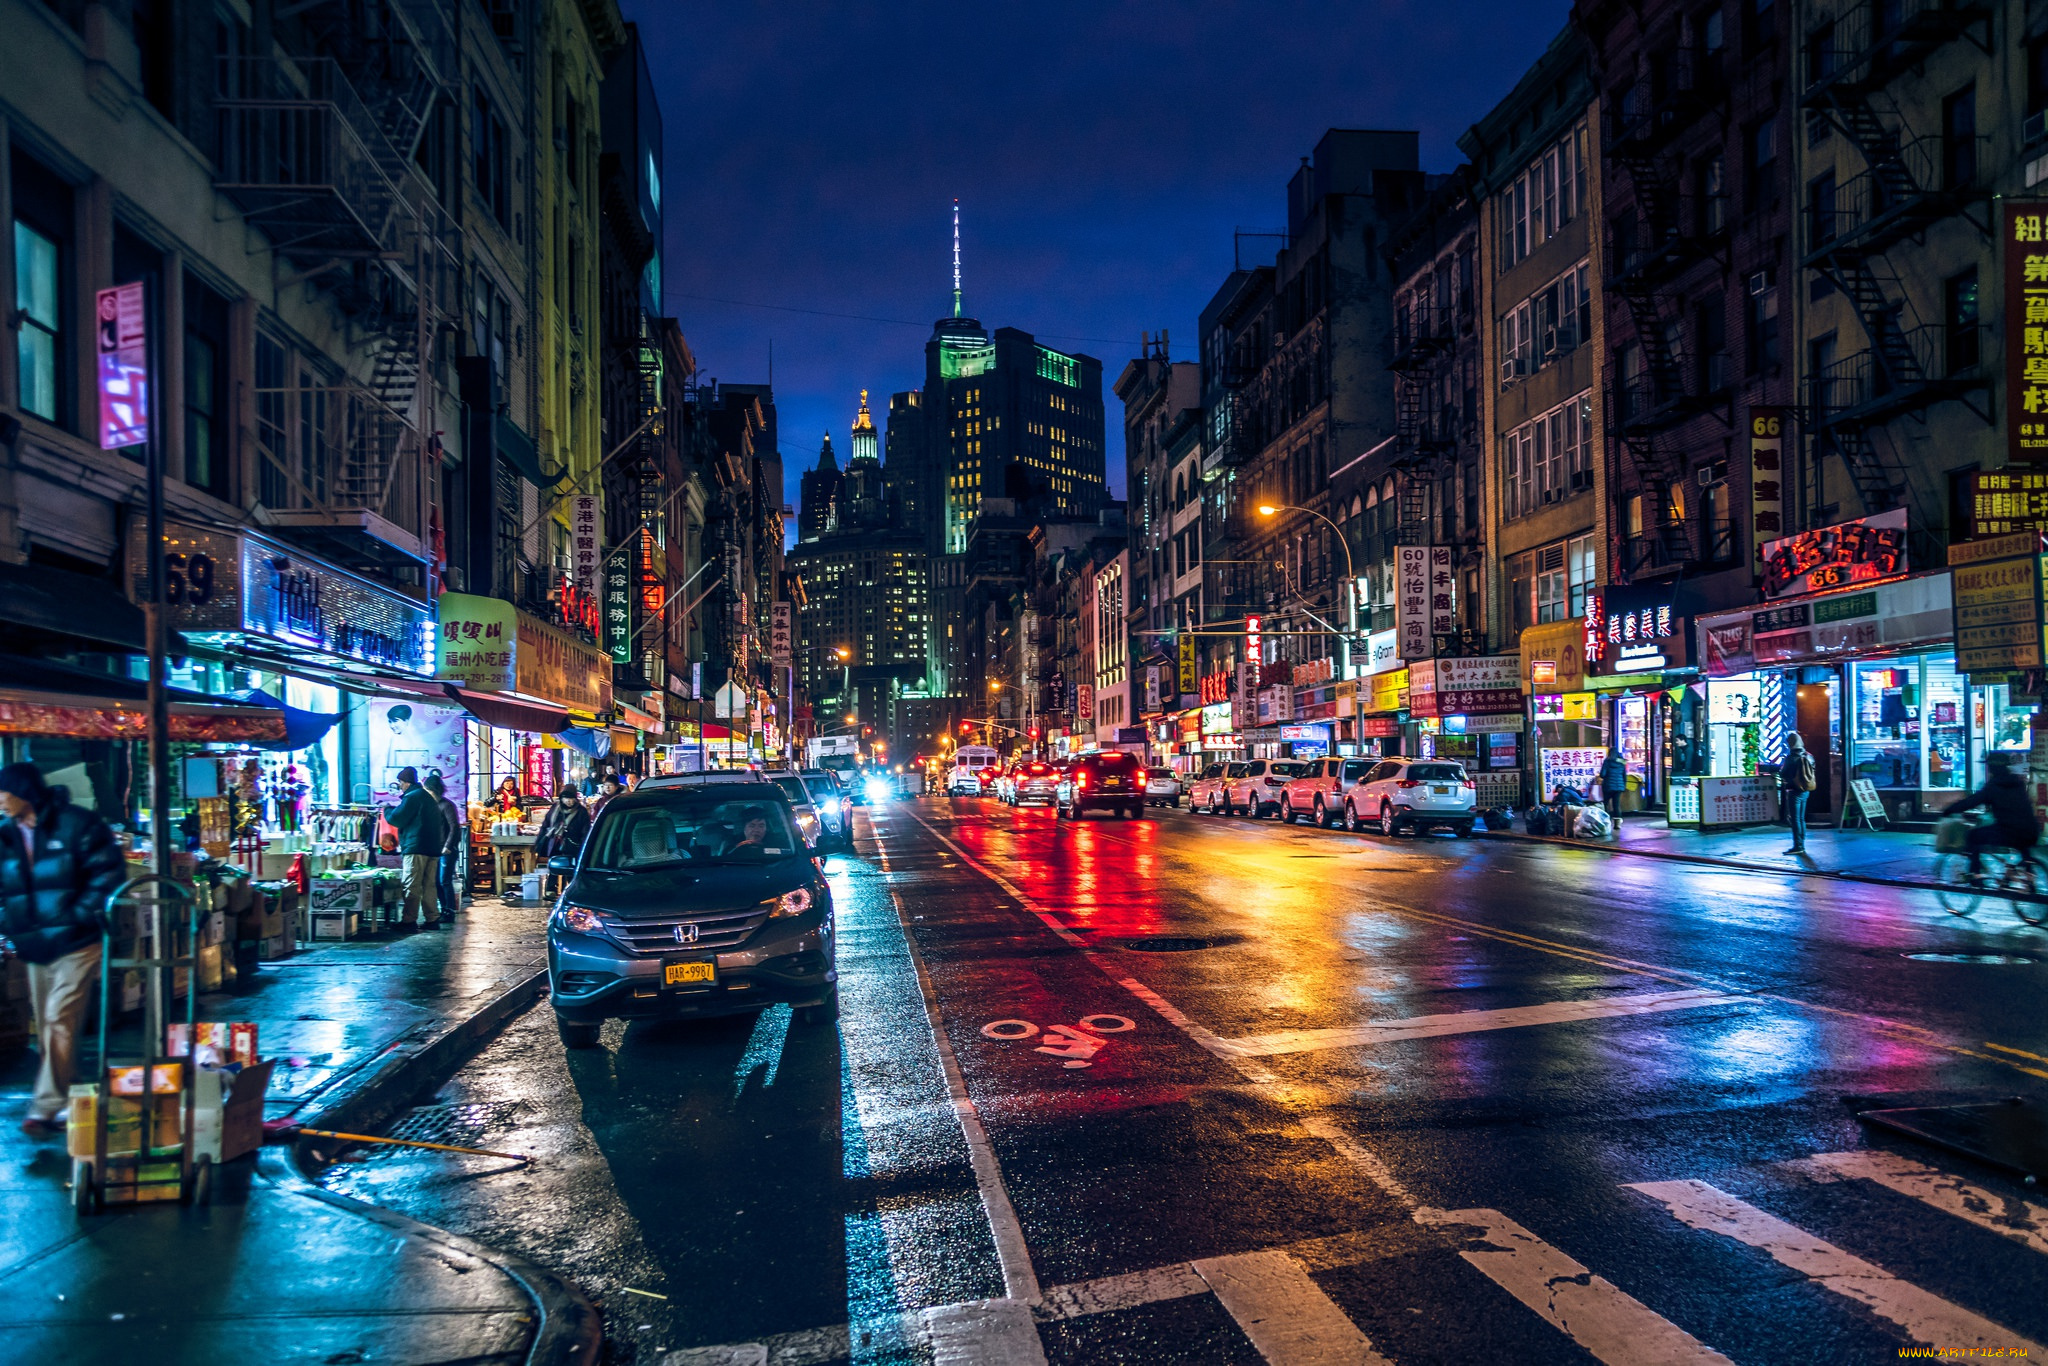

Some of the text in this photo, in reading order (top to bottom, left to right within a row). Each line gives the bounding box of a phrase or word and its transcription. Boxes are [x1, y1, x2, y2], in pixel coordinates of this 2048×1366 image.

[1753, 416, 1780, 436] 66
[164, 553, 214, 606] 69
[1811, 565, 1840, 588] 66
[446, 651, 512, 668] 福州小吃店
[312, 883, 360, 908] Vegetables
[668, 964, 711, 980] HAR-9987
